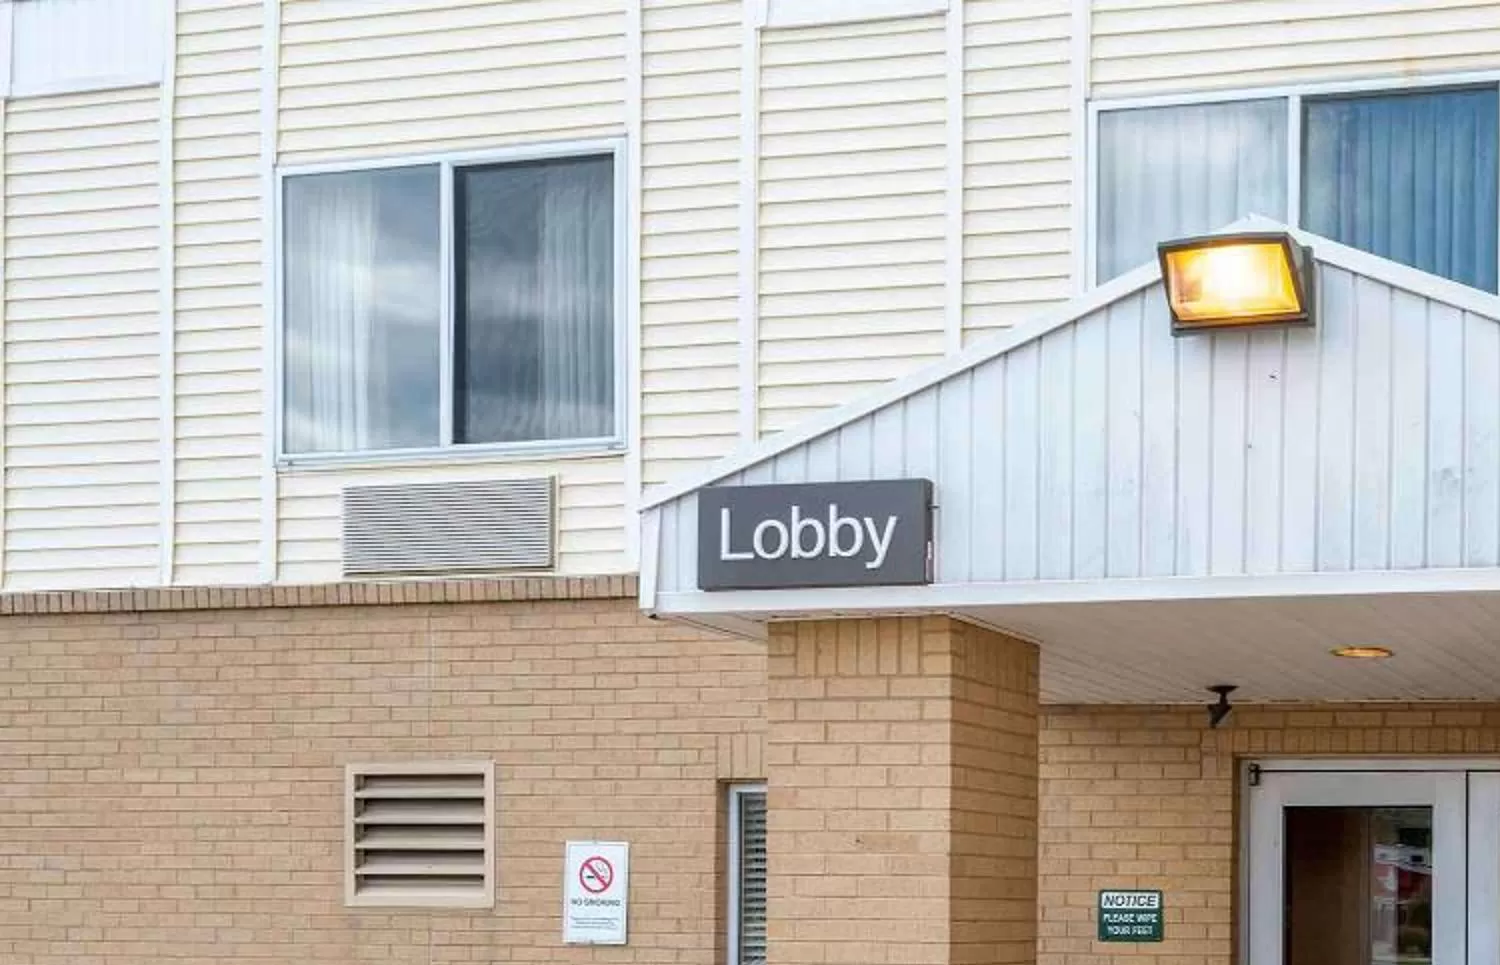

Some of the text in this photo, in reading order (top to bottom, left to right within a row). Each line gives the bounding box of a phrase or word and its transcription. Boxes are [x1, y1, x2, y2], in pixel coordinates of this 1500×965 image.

[720, 504, 897, 569] Lobby
[1103, 895, 1157, 907] NOTICE
[1103, 913, 1135, 923] PLEASE
[1107, 925, 1130, 935] YOUR
